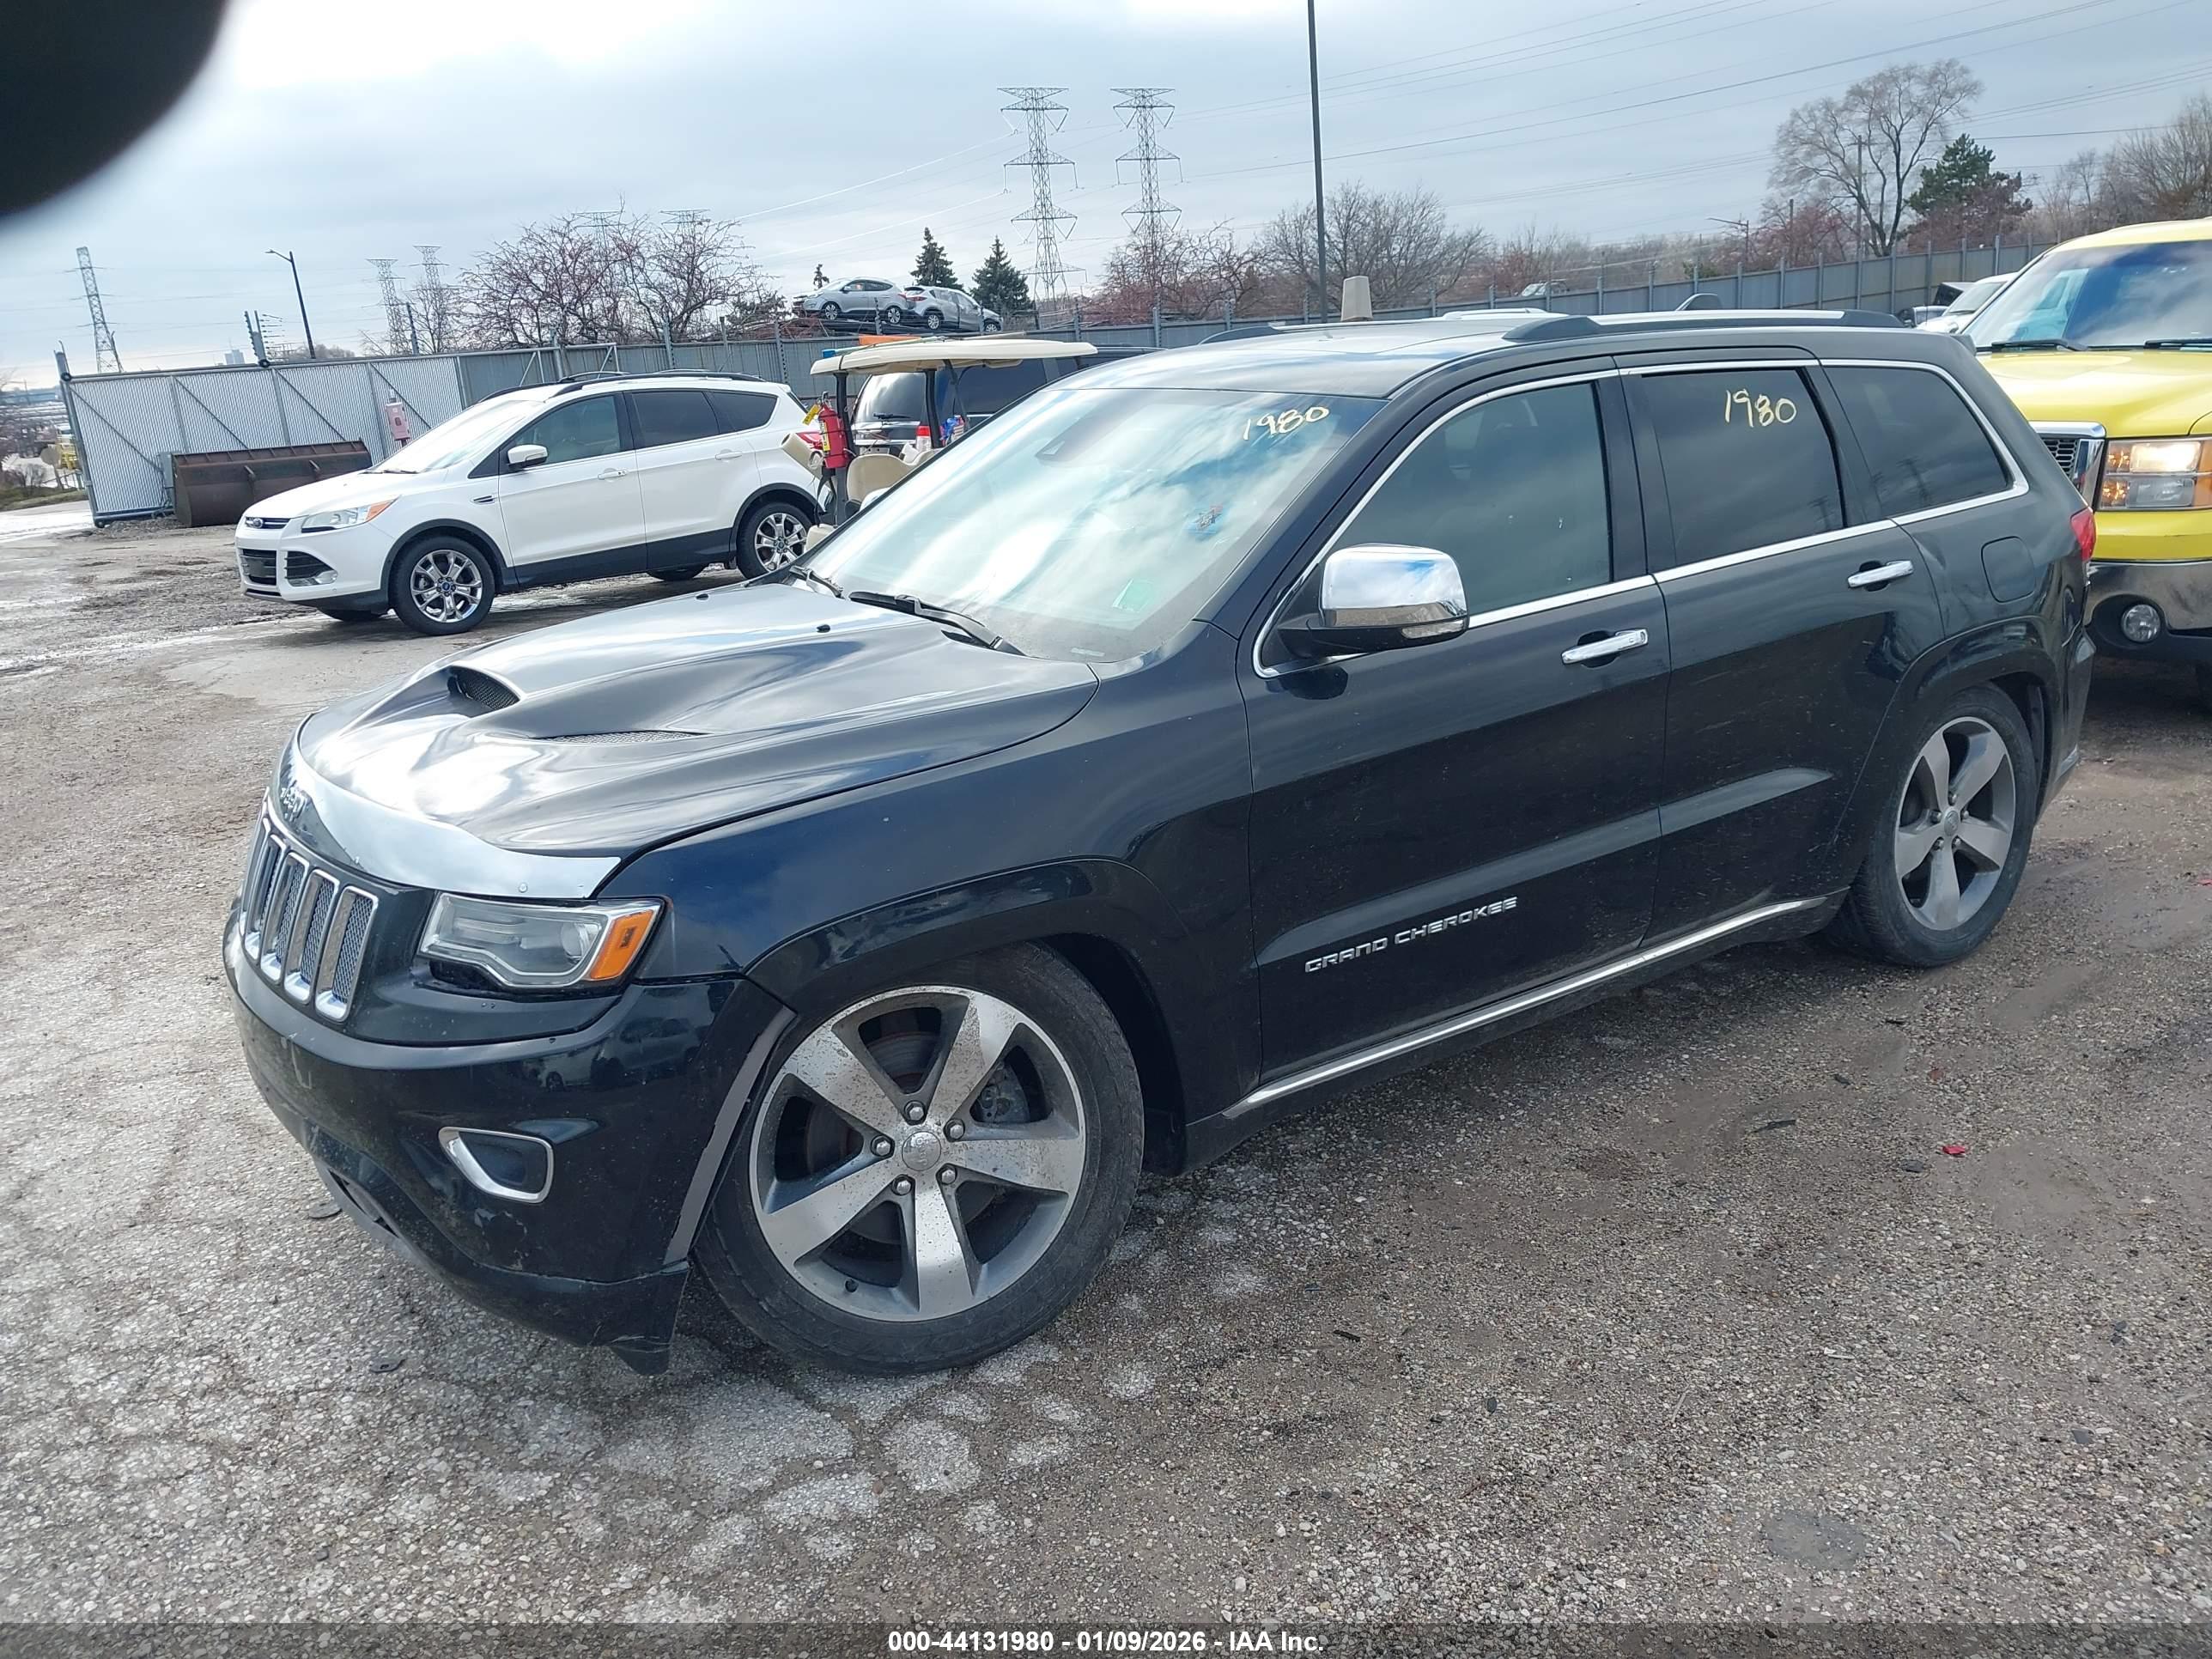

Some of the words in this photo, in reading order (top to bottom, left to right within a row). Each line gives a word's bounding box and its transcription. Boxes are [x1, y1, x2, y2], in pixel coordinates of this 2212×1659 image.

[1243, 406, 1330, 440] 1980
[1724, 388, 1797, 428] 1980
[1304, 937, 1389, 973] GRAND
[1394, 896, 1518, 945] CHEROKEE
